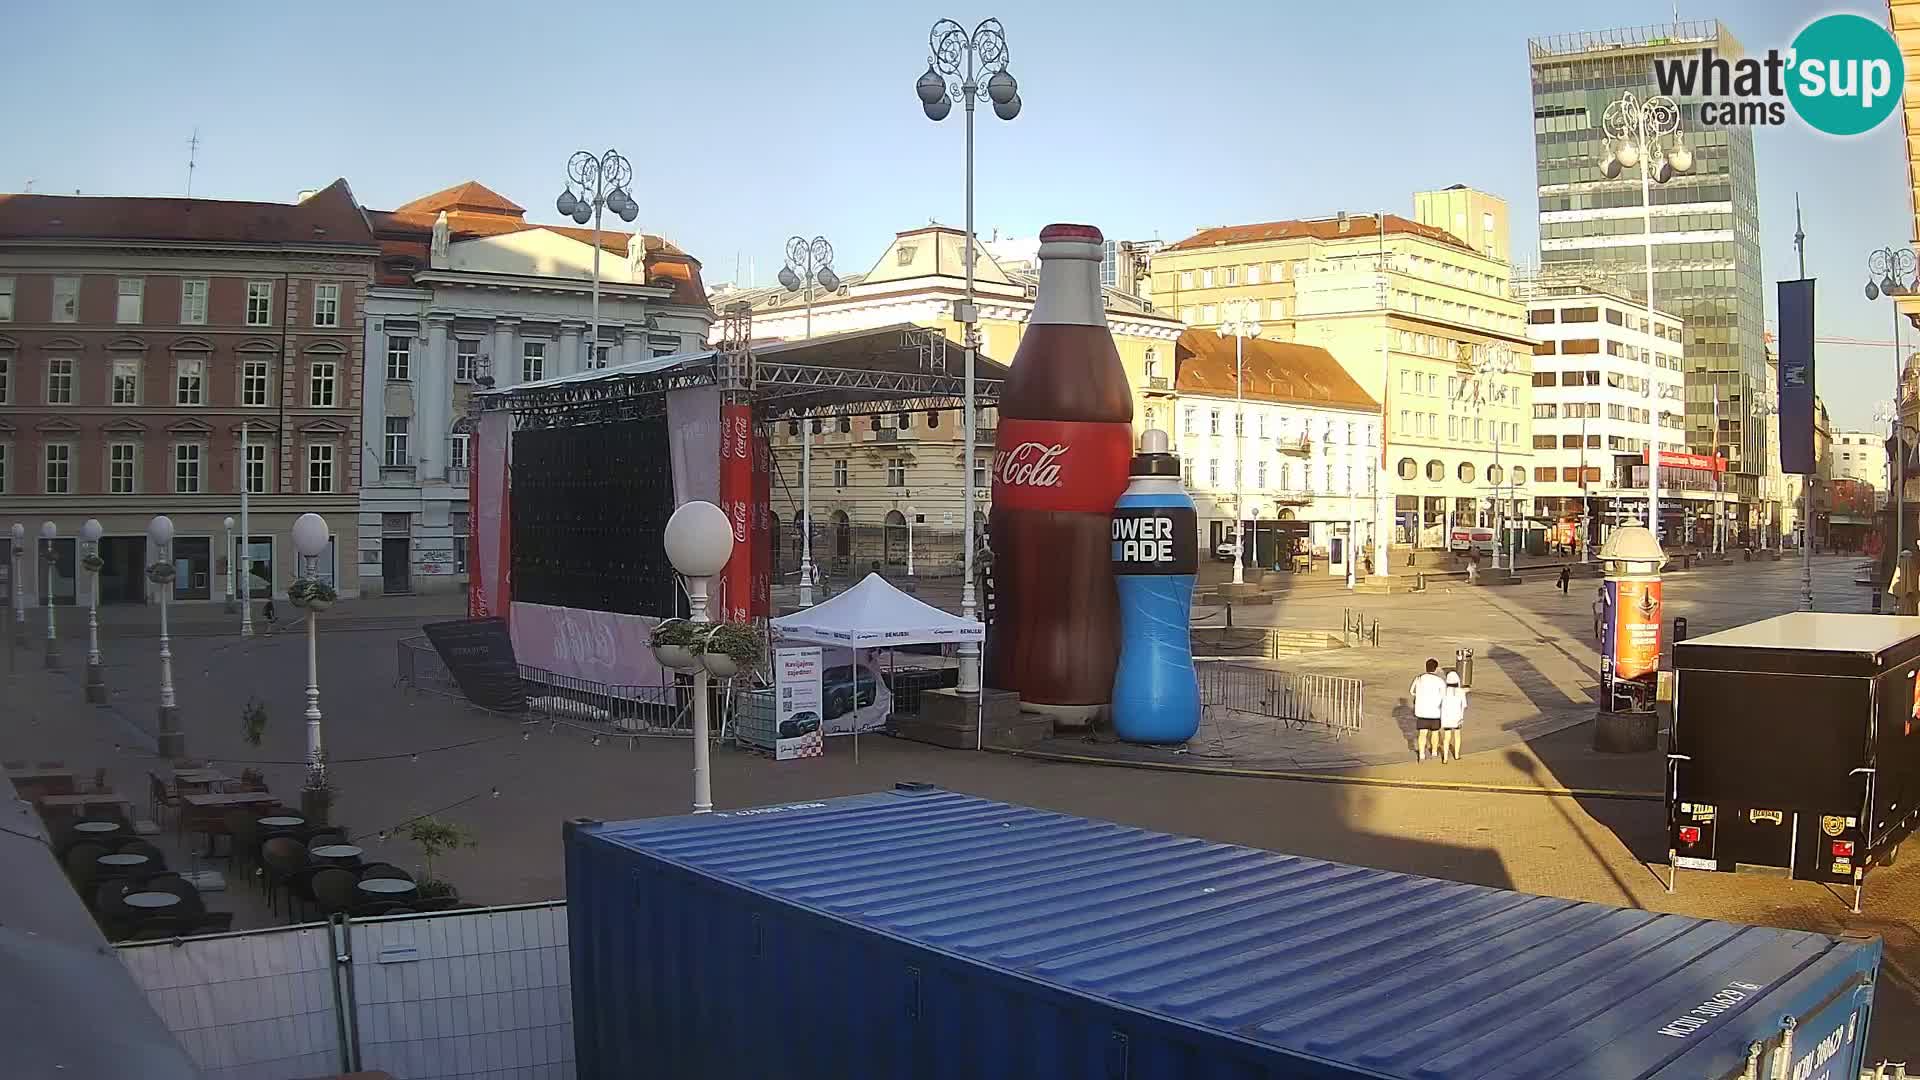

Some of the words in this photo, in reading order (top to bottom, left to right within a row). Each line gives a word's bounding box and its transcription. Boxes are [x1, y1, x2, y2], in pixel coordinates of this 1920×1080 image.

[735, 416, 748, 459] Coca-Cola
[734, 501, 747, 543] Coca-Cola
[1111, 517, 1173, 540] OWER
[1123, 540, 1173, 562] ADE
[1657, 1015, 1709, 1039] MCDU
[1690, 989, 1747, 1018] 300629
